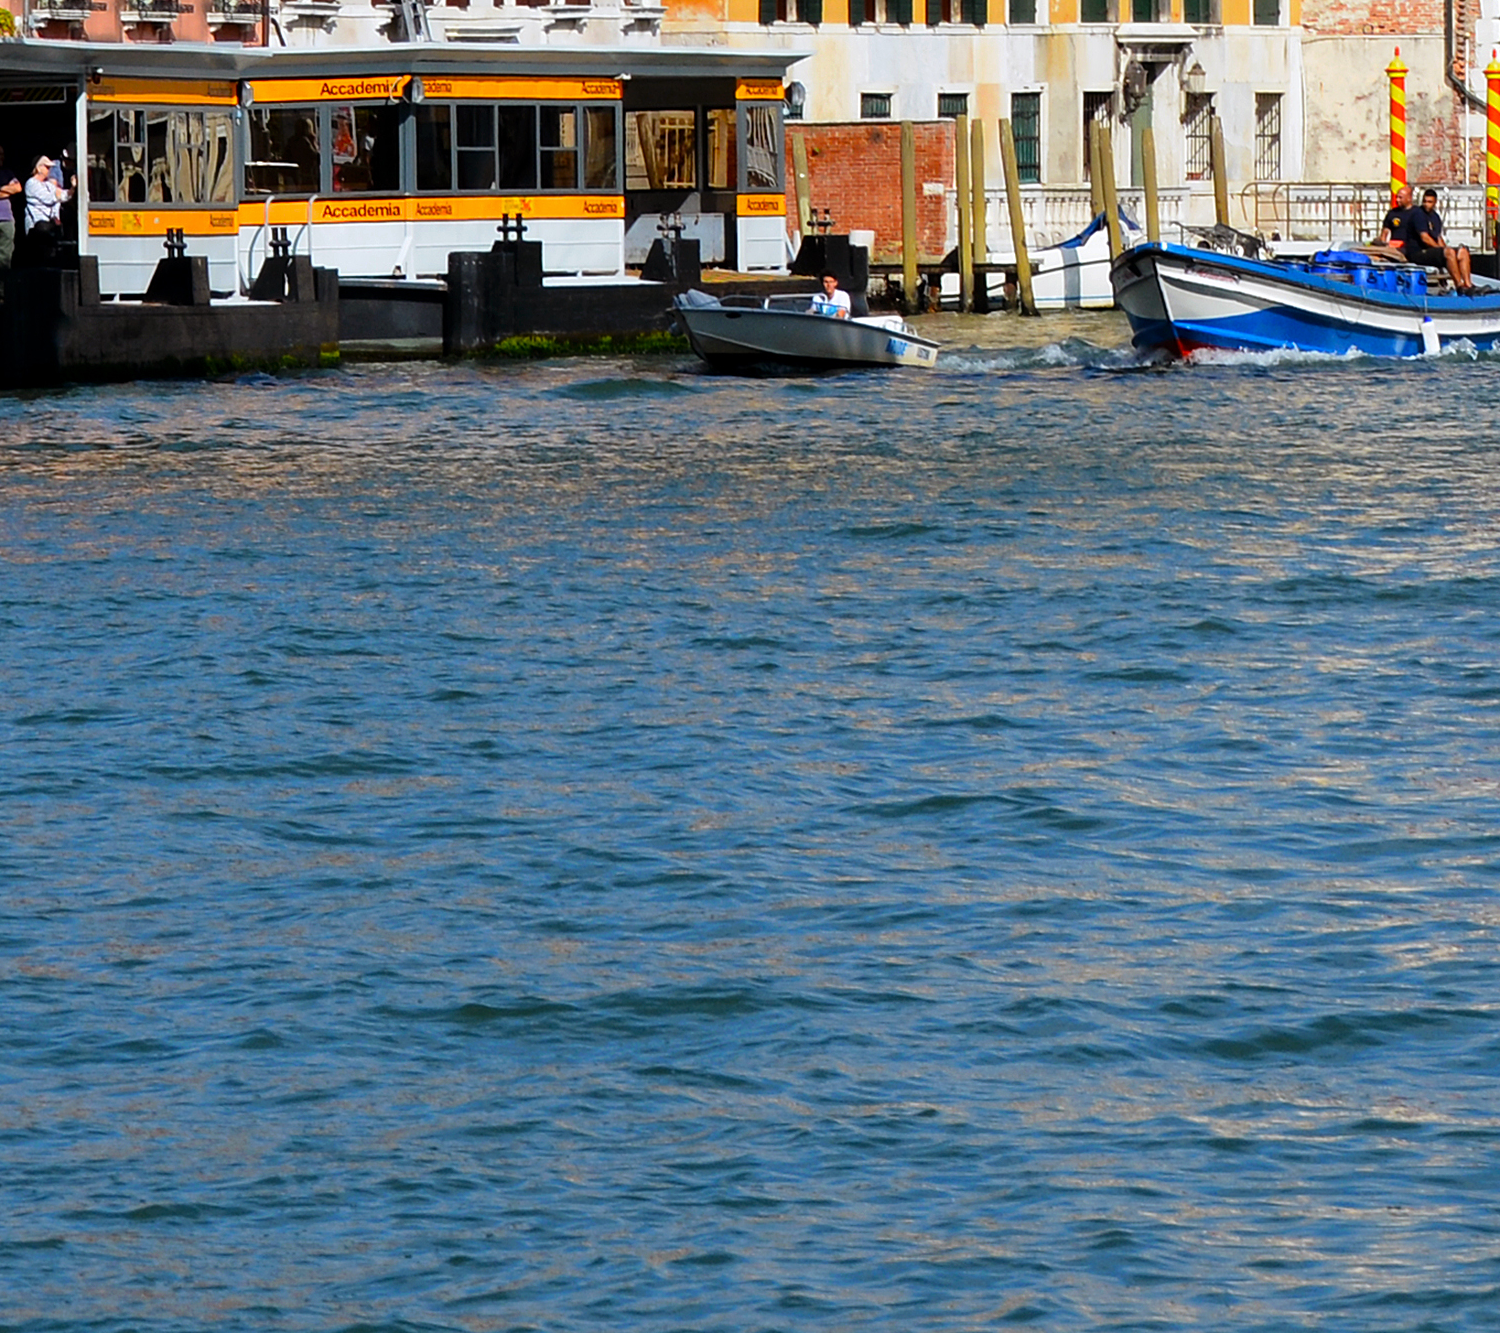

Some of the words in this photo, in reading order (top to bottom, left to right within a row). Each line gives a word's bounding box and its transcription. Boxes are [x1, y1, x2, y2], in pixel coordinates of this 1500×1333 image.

[320, 82, 398, 96] Accademia
[322, 203, 400, 218] Accademia
[415, 202, 453, 216] Accademia
